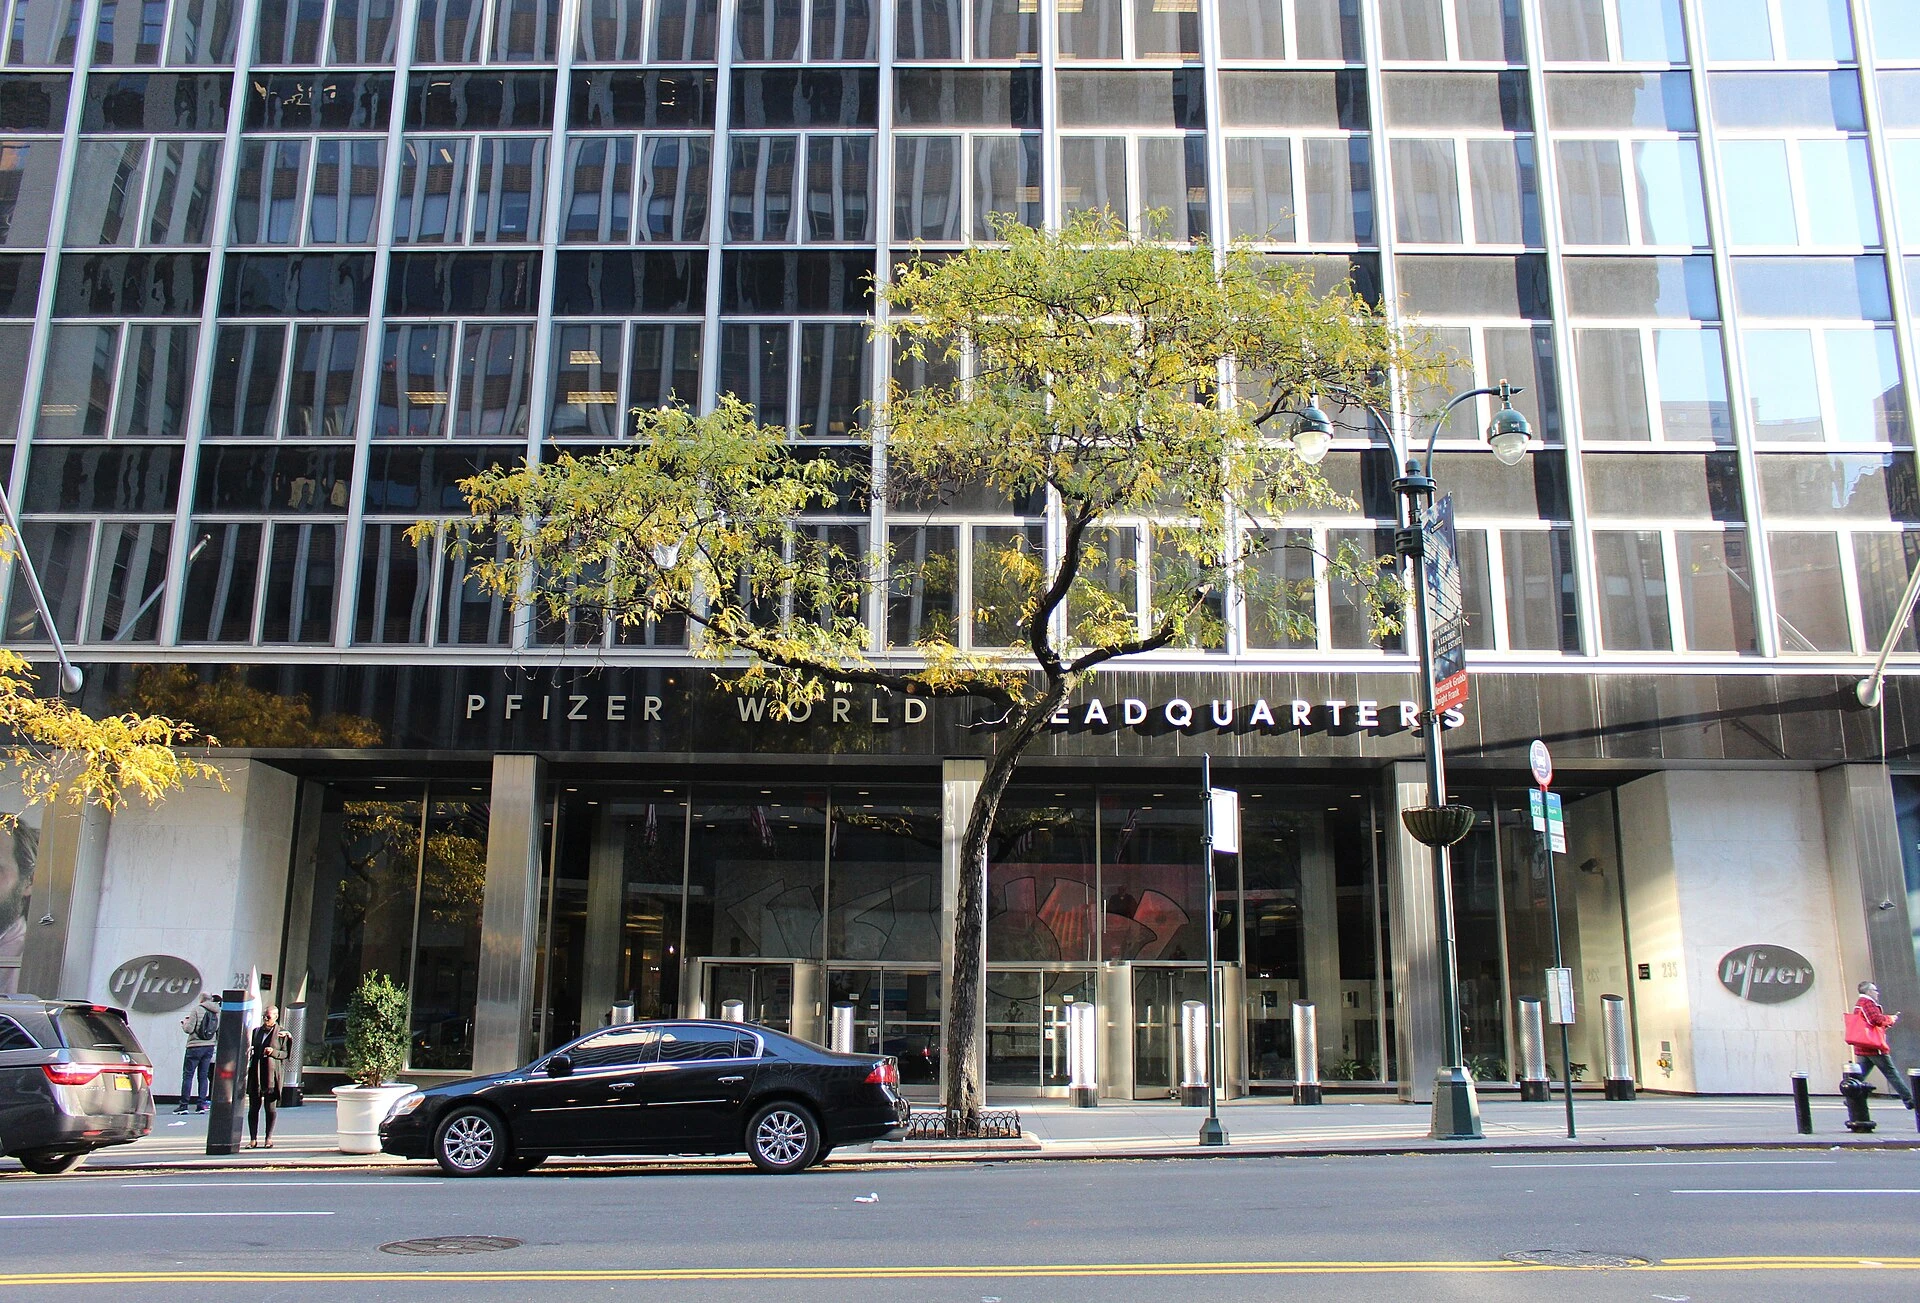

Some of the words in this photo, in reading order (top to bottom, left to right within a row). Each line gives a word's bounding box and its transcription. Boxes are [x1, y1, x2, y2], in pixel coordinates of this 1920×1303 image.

[1452, 672, 1466, 687] Grubb
[1447, 687, 1460, 701] Frank
[466, 694, 662, 721] PFIZER
[737, 696, 927, 723] WORLD
[1005, 698, 1465, 728] EADQUARTERS
[1661, 961, 1678, 978] 235
[1723, 949, 1812, 1000] Pfizer
[114, 961, 200, 1008] Pfizer
[233, 972, 250, 989] 235
